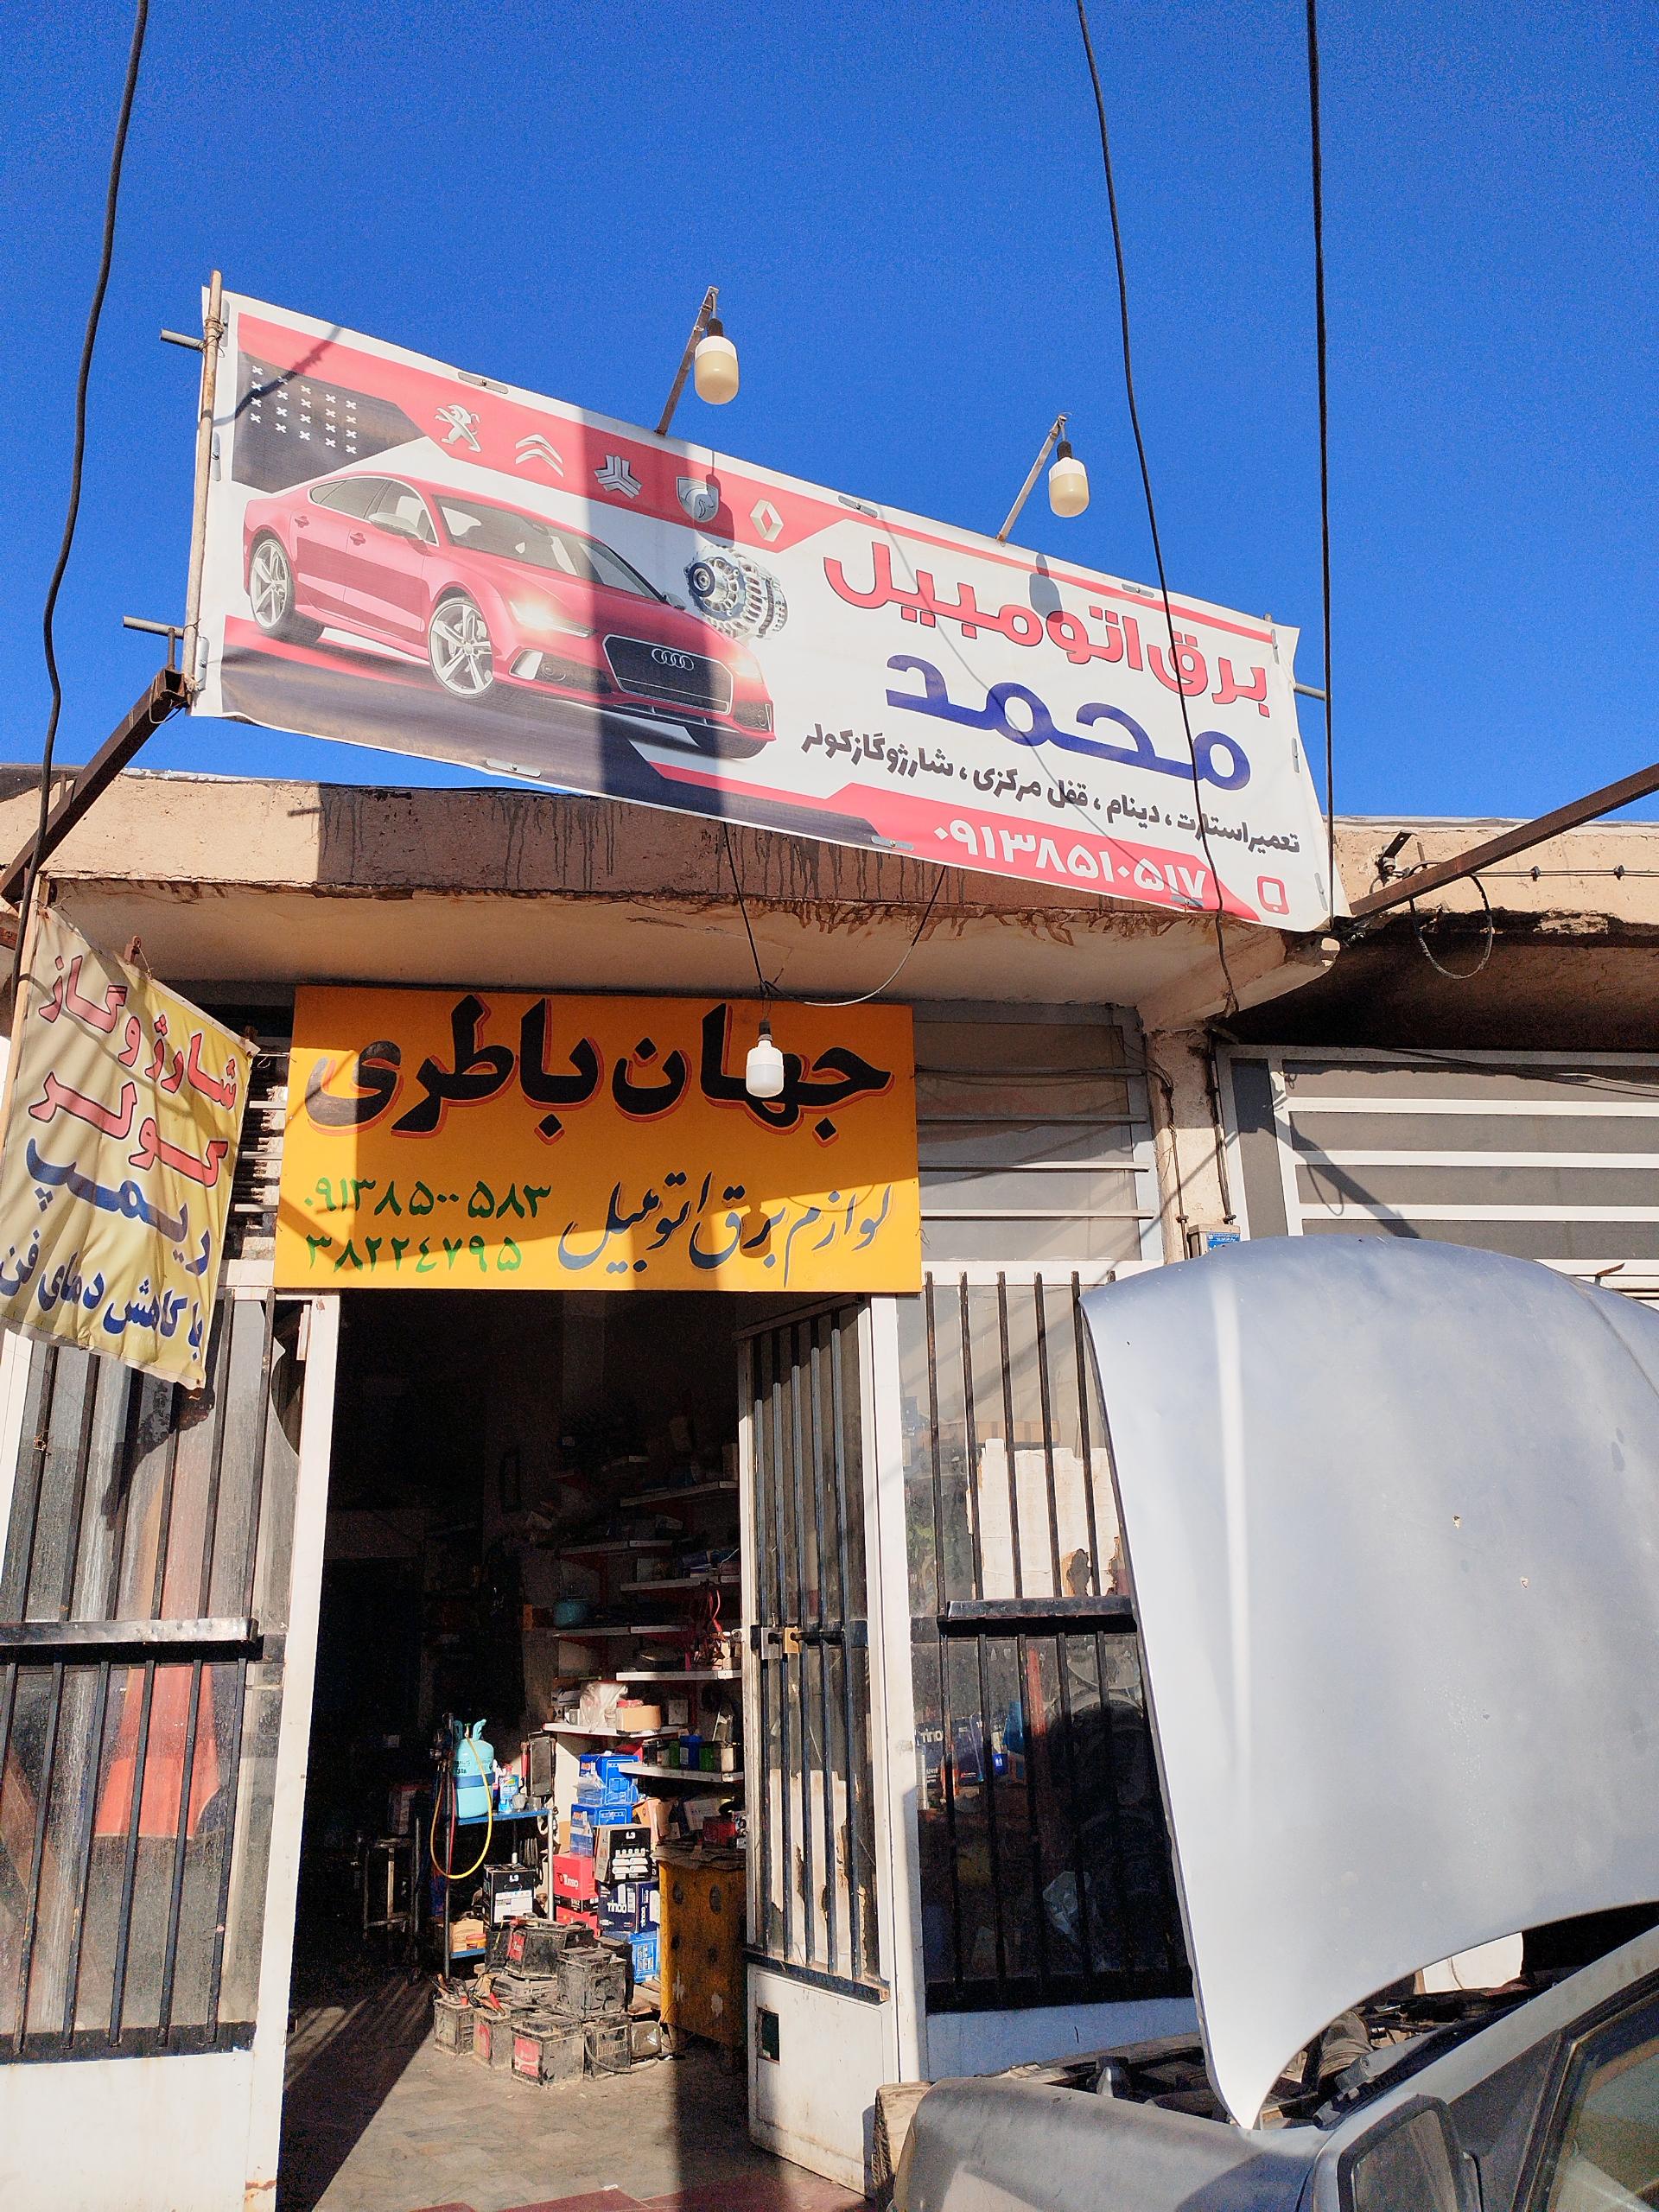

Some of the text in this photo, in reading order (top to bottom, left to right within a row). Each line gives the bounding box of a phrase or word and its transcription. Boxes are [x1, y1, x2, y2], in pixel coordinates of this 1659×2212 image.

[823, 542, 1270, 718] برق اتومبیل
[886, 654, 1250, 791] محمد
[973, 768, 1042, 802] مرکزی
[1047, 779, 1089, 808] قفل
[1106, 794, 1160, 829] دینام
[933, 819, 1206, 899] ۰۹۱۳۸۵۱۰۵۱۷
[1248, 832, 1300, 854] تعمیر
[39, 955, 128, 1033] گاز
[145, 1014, 238, 1111] شارژ
[307, 995, 893, 1147] جهان باطری
[29, 1071, 229, 1188] کولر
[558, 1171, 893, 1289] لوازم برق اتومبیل
[38, 1251, 105, 1311] دمای
[103, 1279, 188, 1337] کاهش
